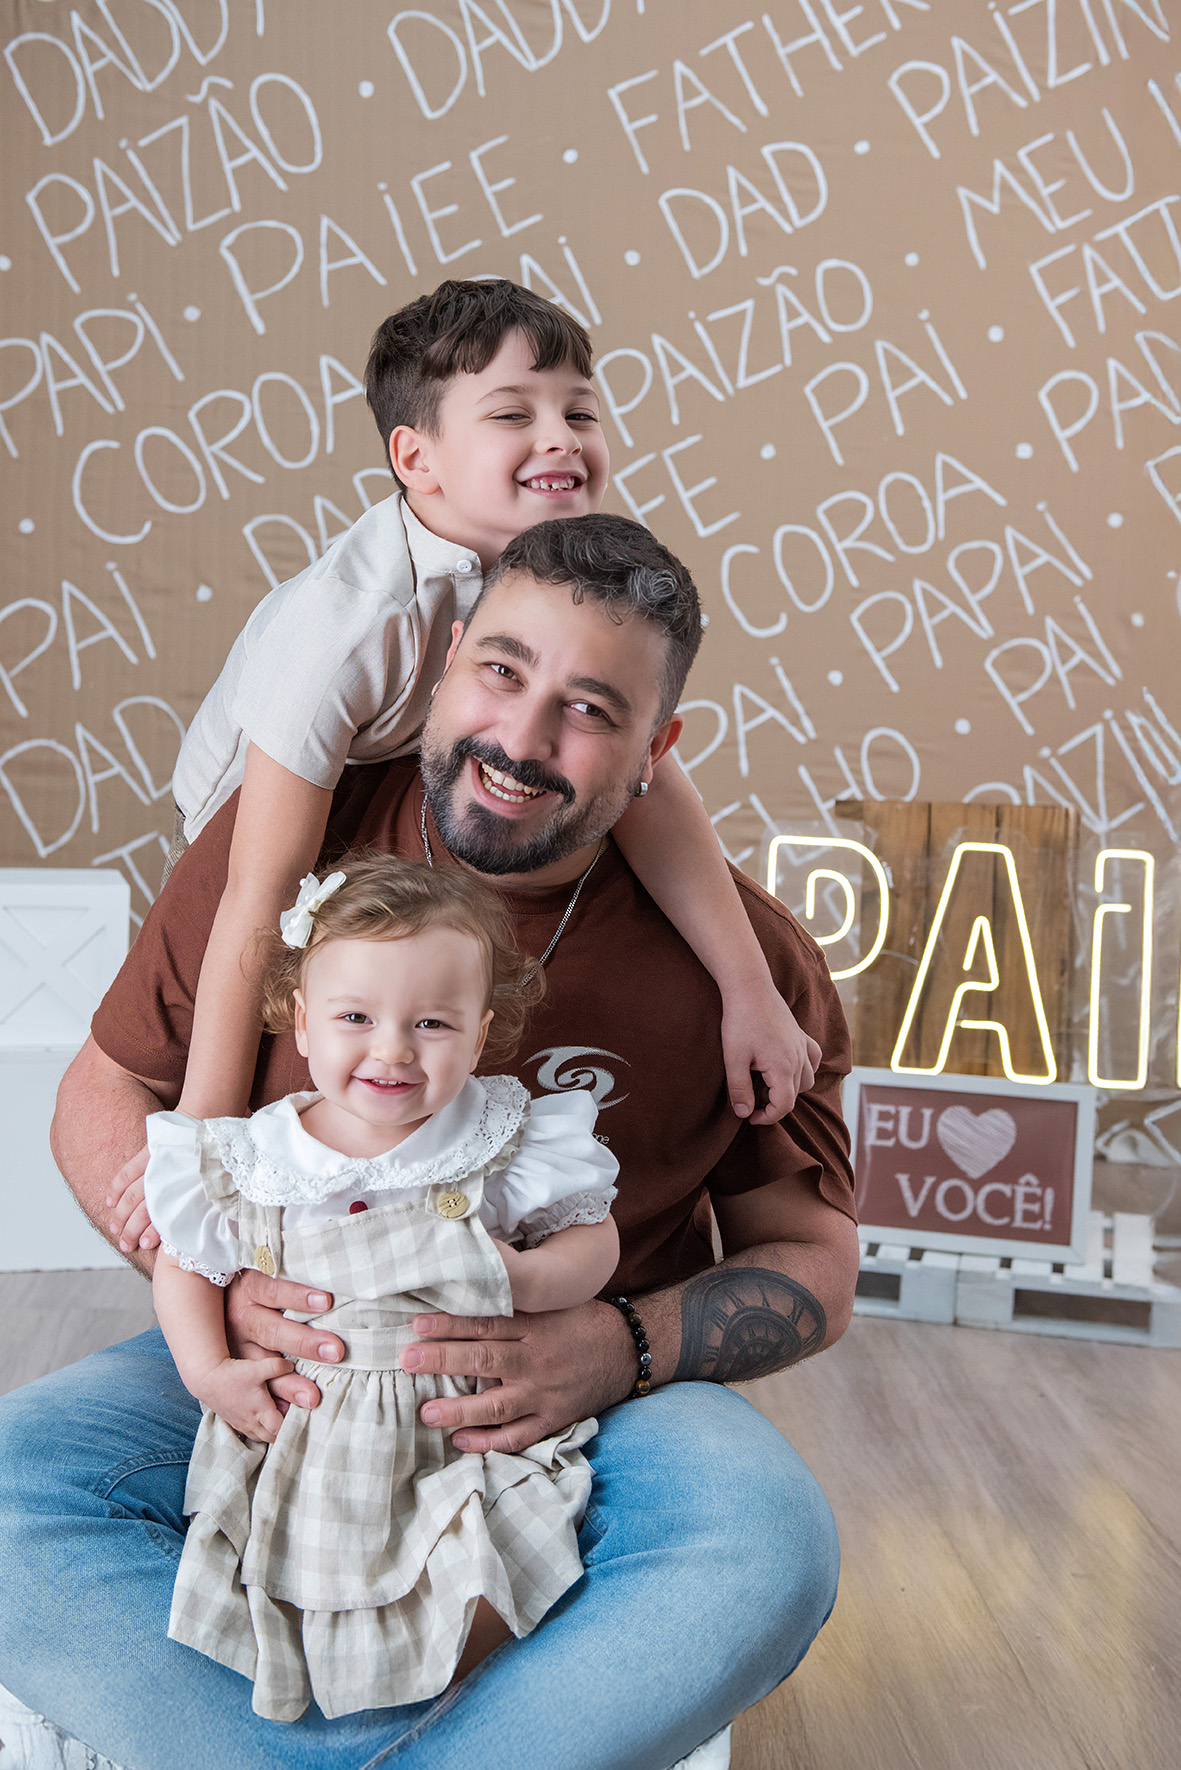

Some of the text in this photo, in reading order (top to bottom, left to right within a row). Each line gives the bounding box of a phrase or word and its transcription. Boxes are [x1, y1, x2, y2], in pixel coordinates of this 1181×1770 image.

[607, 0, 931, 175] FATHE
[658, 140, 828, 279] DAD
[956, 107, 1134, 271] MEU
[721, 451, 1008, 637] COROA
[866, 1102, 934, 1150] EU
[895, 1172, 1056, 1231] VOCÊ!
